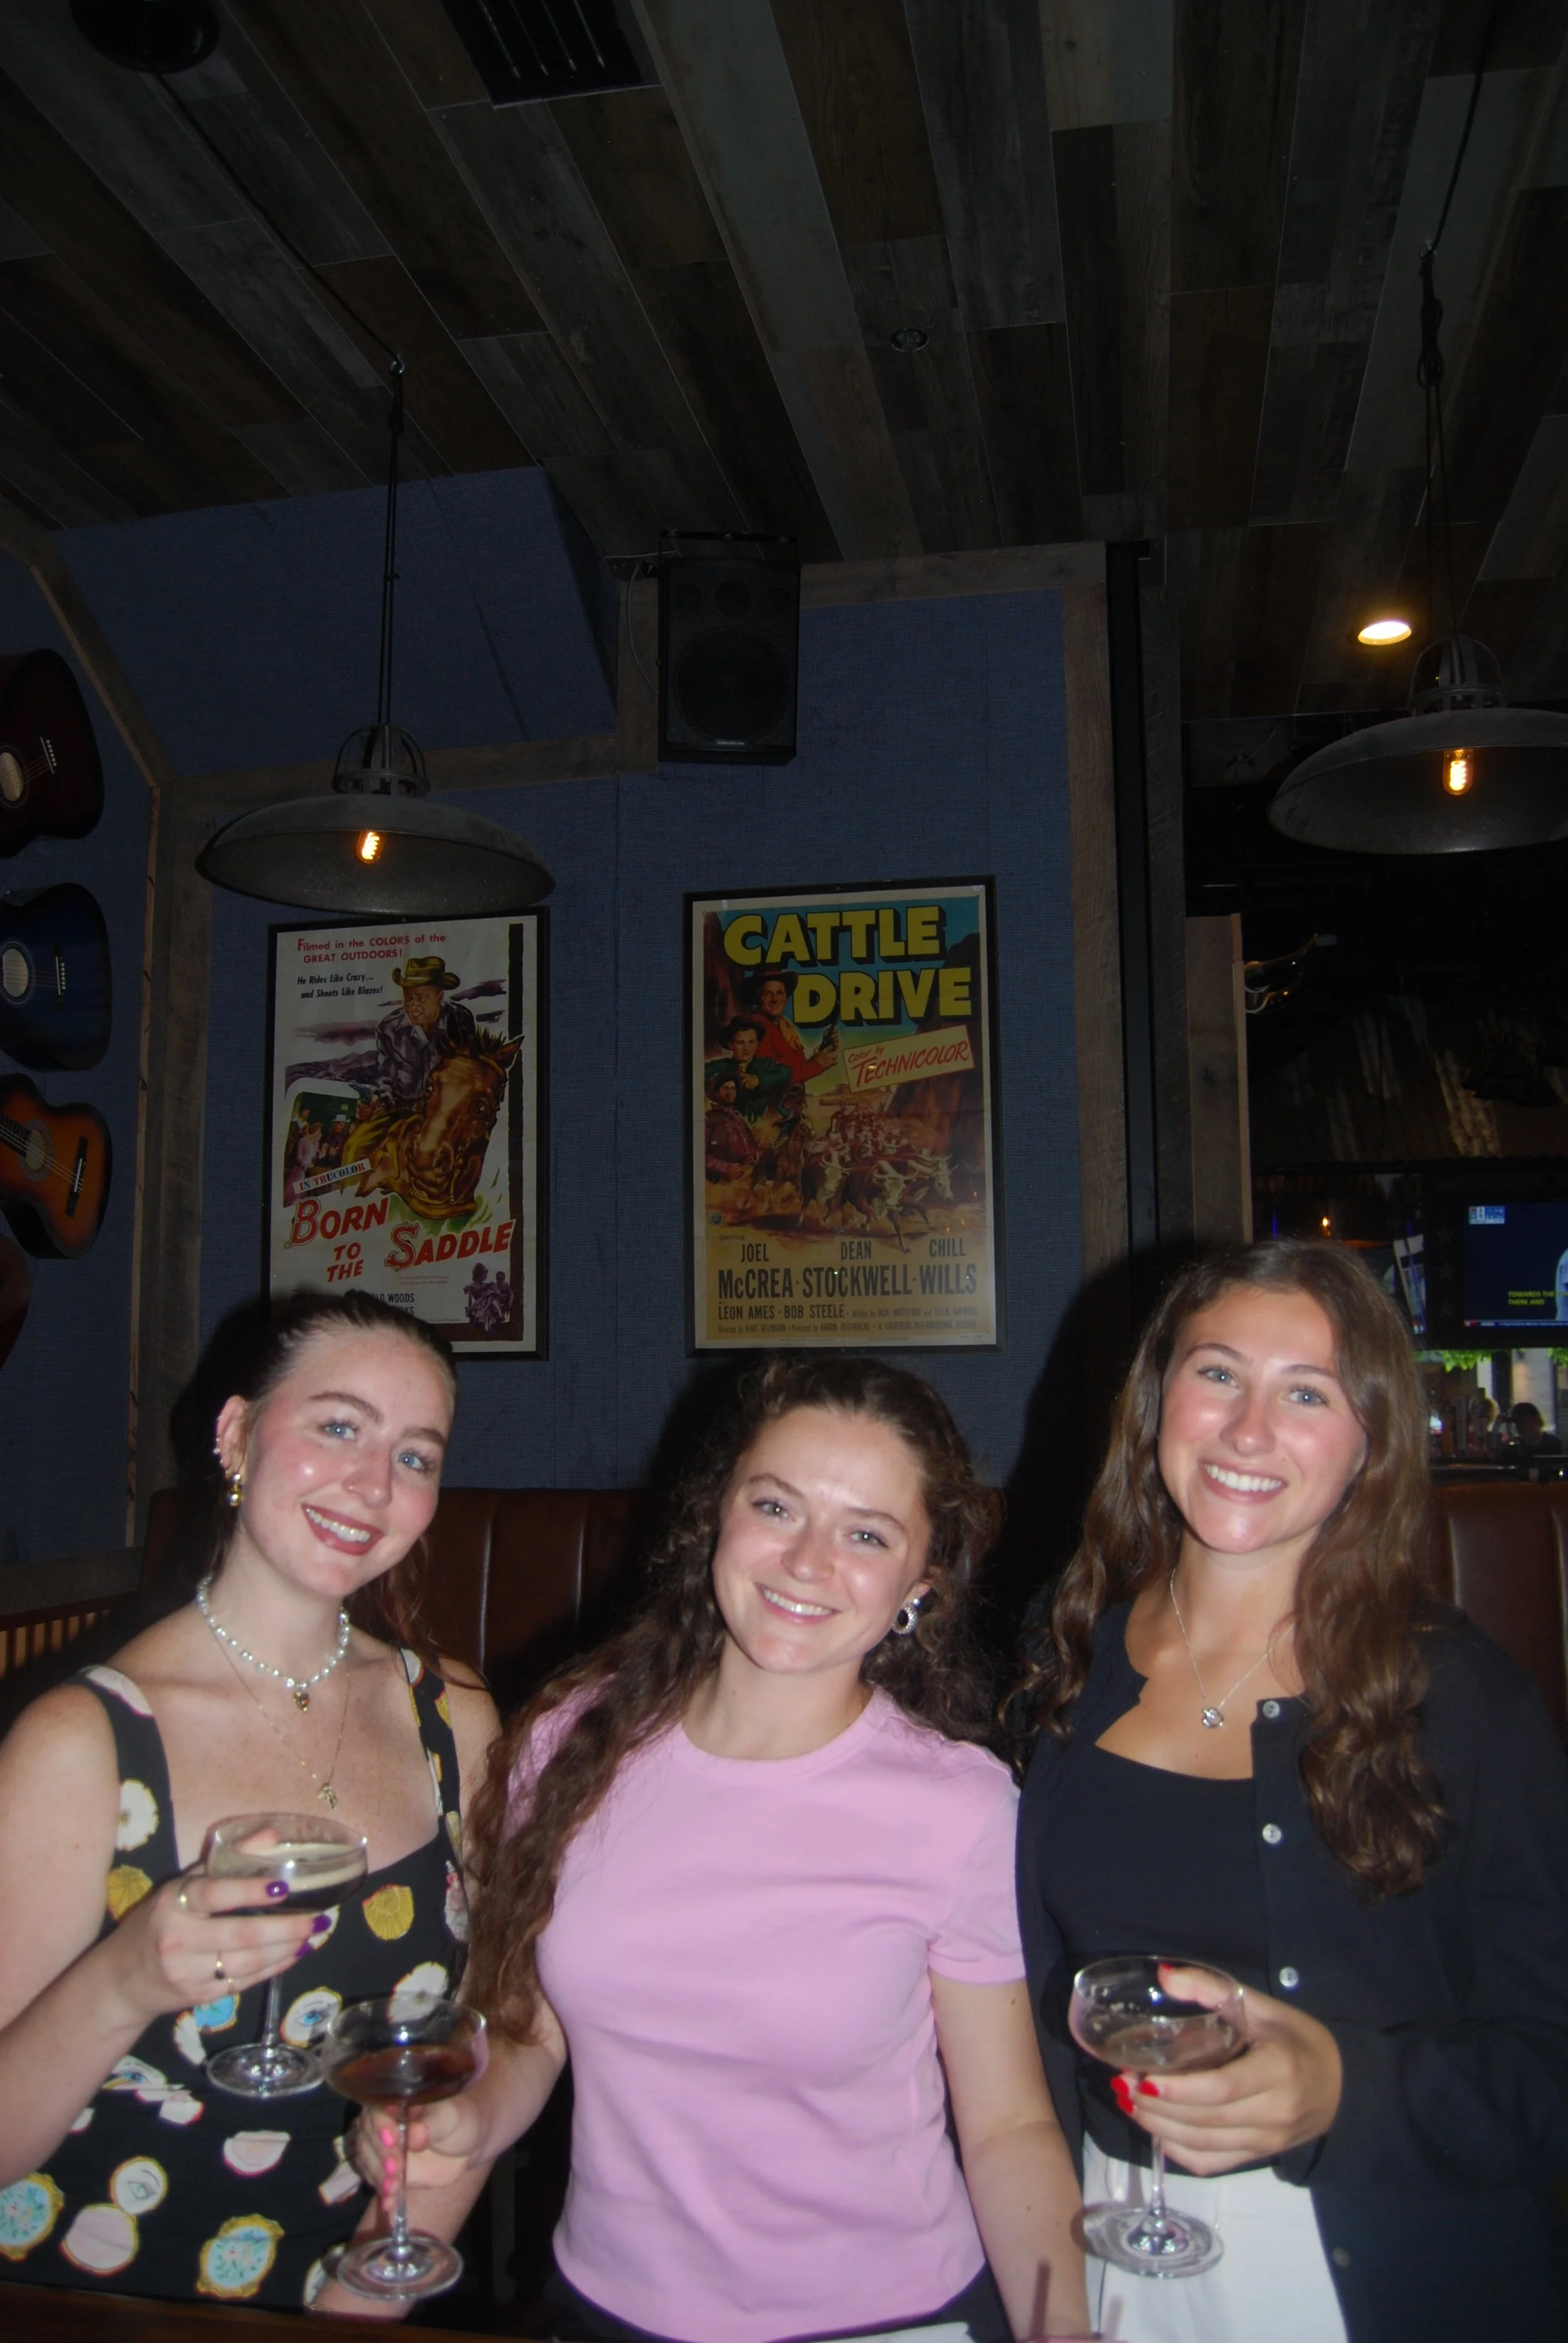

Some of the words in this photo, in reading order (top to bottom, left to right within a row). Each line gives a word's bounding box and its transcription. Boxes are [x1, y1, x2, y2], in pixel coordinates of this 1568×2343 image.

[297, 938, 331, 952] Filmed
[335, 940, 344, 949] in
[349, 939, 364, 948] the
[369, 935, 410, 946] COLORS
[415, 934, 425, 943] of
[430, 933, 446, 942] the
[723, 904, 947, 968] CATTLE
[304, 954, 336, 964] GREAT
[341, 949, 403, 961] OUTDOORS!
[297, 976, 306, 985] He
[309, 975, 327, 984] Rides
[330, 974, 344, 982] Like
[301, 990, 314, 998] and
[316, 988, 339, 997] Shoots
[341, 987, 355, 996] Like
[358, 986, 383, 995] Blazes!
[793, 967, 972, 1026] DRIVE
[848, 1049, 872, 1063] Color
[875, 1045, 886, 1055] by
[851, 1041, 969, 1088] TECHNICOLOR
[299, 1180, 310, 1191] IN
[313, 1162, 366, 1186] TRUCOLOR
[284, 1197, 389, 1248] BORN
[334, 1242, 361, 1261] TO
[384, 1221, 514, 1272] SADDLE
[741, 1243, 770, 1262] JOEL
[840, 1240, 872, 1260] DEAN
[929, 1238, 967, 1258] CHILL
[326, 1259, 364, 1283] THE
[718, 1268, 793, 1300] McCREA
[802, 1264, 913, 1299] STOCKWELL
[919, 1263, 977, 1295] WILLS
[388, 1294, 415, 1303] WOODS
[718, 1305, 743, 1320] LEON
[748, 1305, 775, 1320] AMES
[784, 1305, 804, 1319] BOB
[809, 1304, 845, 1319] STEELE
